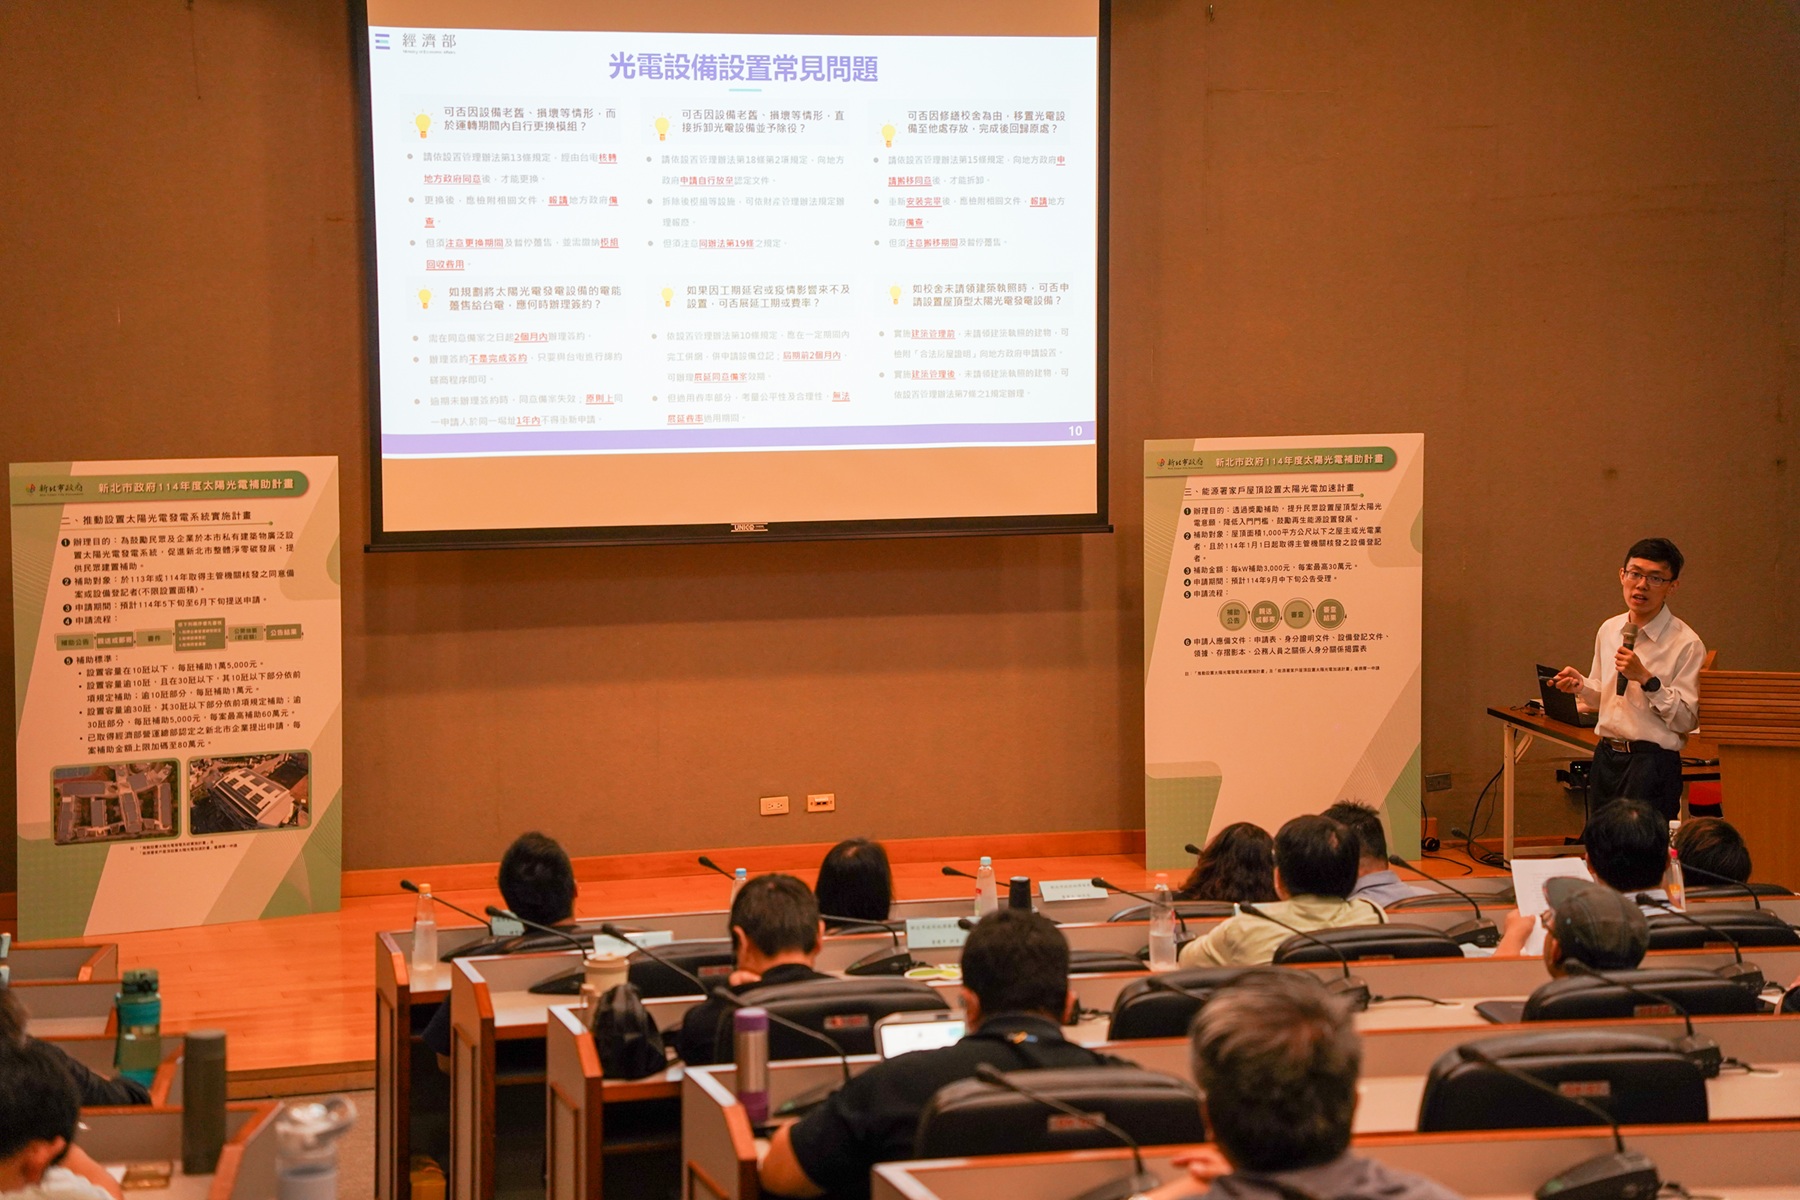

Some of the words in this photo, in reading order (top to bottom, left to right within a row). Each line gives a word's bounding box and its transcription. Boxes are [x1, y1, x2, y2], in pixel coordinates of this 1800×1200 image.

[402, 33, 457, 48] 經濟部
[608, 51, 879, 82] 光電設備設置常見問題
[444, 106, 616, 119] 可否因設備老舊、損壞等情形，而
[682, 109, 845, 121] 可否因設備老舊、損壞等情形，直
[907, 110, 1066, 121] 可否因修繕校舍為由，移置光電設
[444, 120, 586, 132] 於運轉期間內自行更換模組？
[907, 123, 1057, 134] 備至他處存放，完成後回歸原處？
[449, 285, 622, 297] 如規劃將太陽光電發電設備的電能
[687, 284, 851, 295] 如果因工期延宕或疫情影響來不及
[913, 283, 1069, 294] 如校舍未請領建築執照時，可否申
[913, 295, 1062, 307] 請設置屋頂型太陽光電發電設備？
[1069, 425, 1083, 436] 10
[1215, 453, 1384, 467] 新北市政府114年度太陽光電補助計畫
[39, 483, 83, 493] 新北市政府
[98, 478, 294, 494] 新北市政府114年度太陽光電補助計畫
[1184, 483, 1354, 497] 三、能源署家戶屋頂設置太陽光電加速計畫
[61, 510, 252, 525] 二、推動設置太陽光電發電系統實施計畫
[1193, 589, 1229, 598] 申請流程：
[75, 616, 118, 625] 申請流程：
[76, 655, 119, 665] 補助標準：
